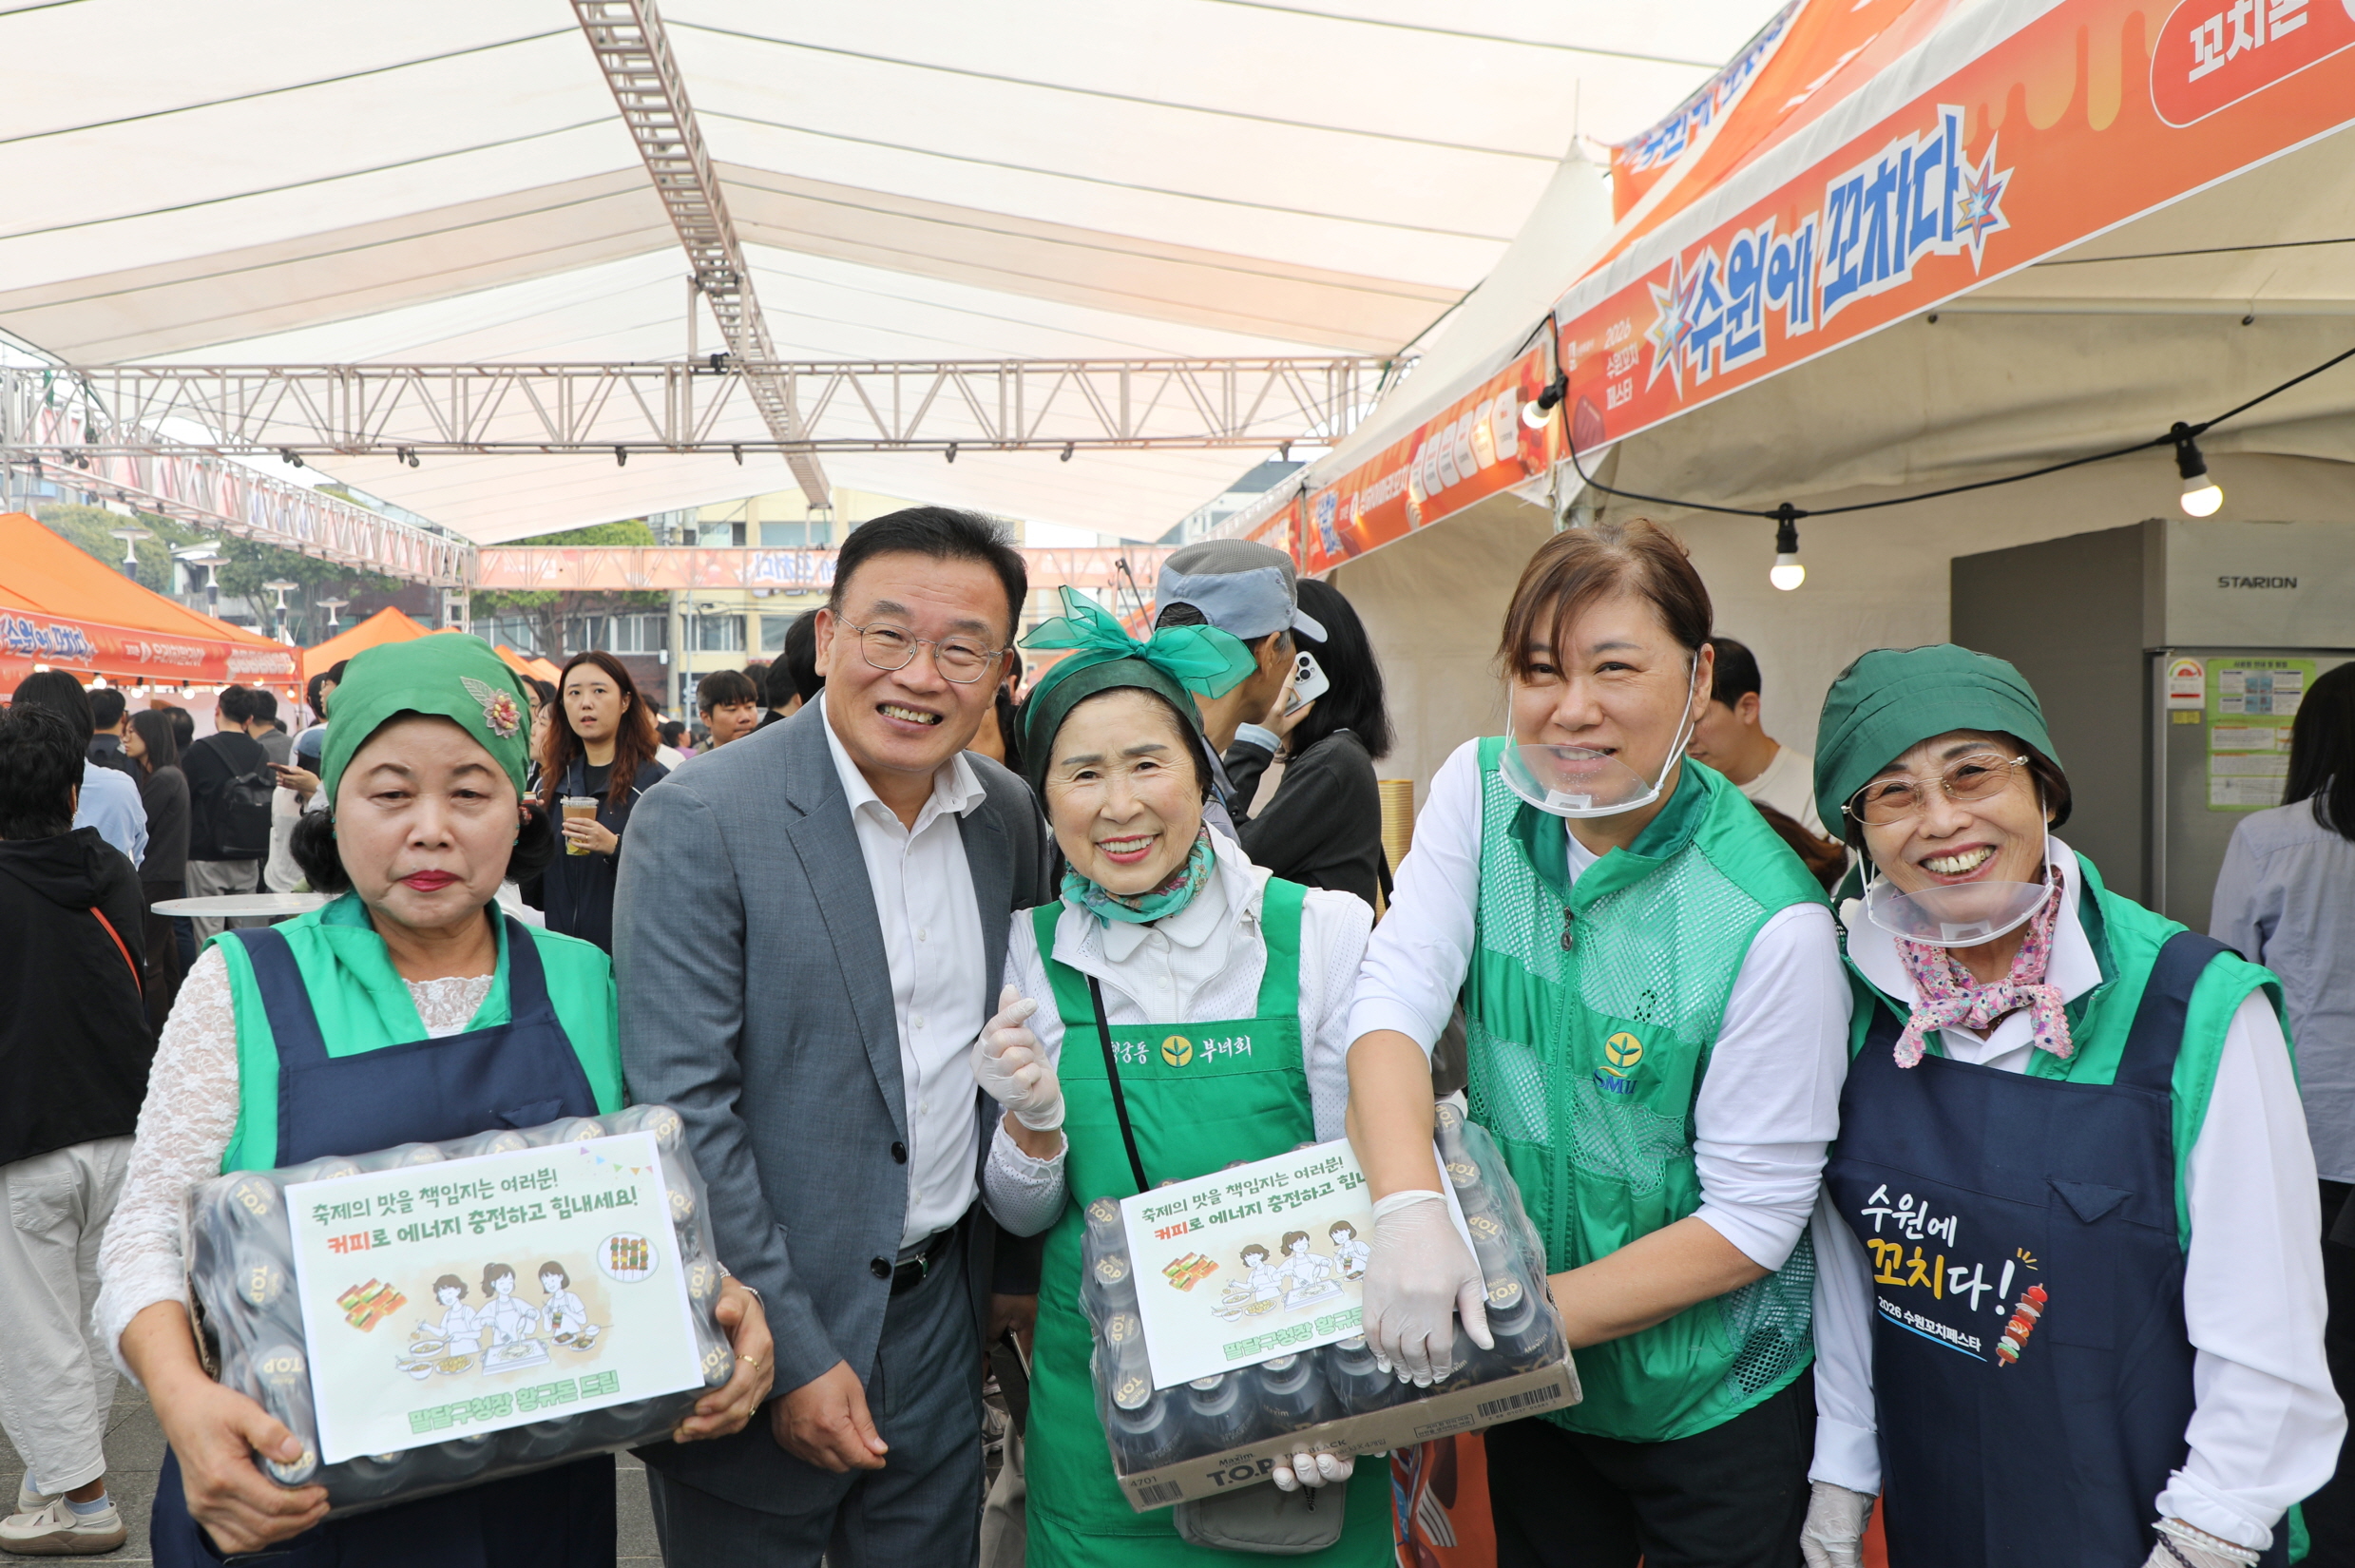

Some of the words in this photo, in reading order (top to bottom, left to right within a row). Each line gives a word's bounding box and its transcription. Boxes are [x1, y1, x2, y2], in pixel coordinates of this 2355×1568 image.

[1688, 220, 1816, 376] 수원에
[1822, 111, 1961, 316] 꼬치다
[1604, 316, 1632, 350] 2026
[1607, 341, 1639, 379] 수원꼬치
[1606, 376, 1633, 411] 페스타
[2217, 576, 2298, 588] STARION
[8, 618, 52, 656] 수원에
[1199, 1034, 1252, 1063] 부녀회
[1446, 1162, 1475, 1177] T.O.P
[312, 1198, 372, 1226] 축제의
[377, 1190, 413, 1216] 맛을
[419, 1178, 494, 1208] 책임지는
[501, 1167, 559, 1192] 여러분!
[1141, 1198, 1188, 1223] 축제의
[1192, 1188, 1222, 1210] 맛을
[1225, 1172, 1289, 1197] 책임지는
[1293, 1156, 1344, 1178] 여러분!
[327, 1229, 392, 1253] 커피로
[397, 1216, 462, 1242] 에너지
[468, 1202, 547, 1234] 충전하고
[549, 1185, 639, 1220] 힘내세요!
[1089, 1203, 1113, 1222] T.O.P
[1154, 1217, 1205, 1241] 커피로
[1208, 1200, 1263, 1224] 에너지
[1267, 1181, 1335, 1214] 충전하고
[1469, 1216, 1499, 1235] T.O.P
[1861, 1184, 1958, 1248] 수원에
[1096, 1258, 1121, 1278] T.O.P
[1867, 1238, 2016, 1315] 꼬치다!
[1486, 1277, 1507, 1289] Maxim
[1488, 1283, 1519, 1302] T.O.P
[1112, 1314, 1126, 1342] T.O.P
[1878, 1295, 1902, 1319] 2026
[1904, 1310, 1982, 1352] 수원꼬치페스타
[1222, 1321, 1313, 1362] 팔달구청장
[1523, 1333, 1548, 1354] Maxim
[408, 1391, 513, 1435] 팔달구청장
[515, 1379, 579, 1412] 황규돈
[579, 1369, 621, 1399] 드림
[1117, 1377, 1143, 1402] T.O.P
[1219, 1453, 1254, 1466] Maxim
[1308, 1439, 1347, 1454] BLACK
[1130, 1476, 1158, 1488] 4701
[1206, 1458, 1276, 1487] T.O.P
